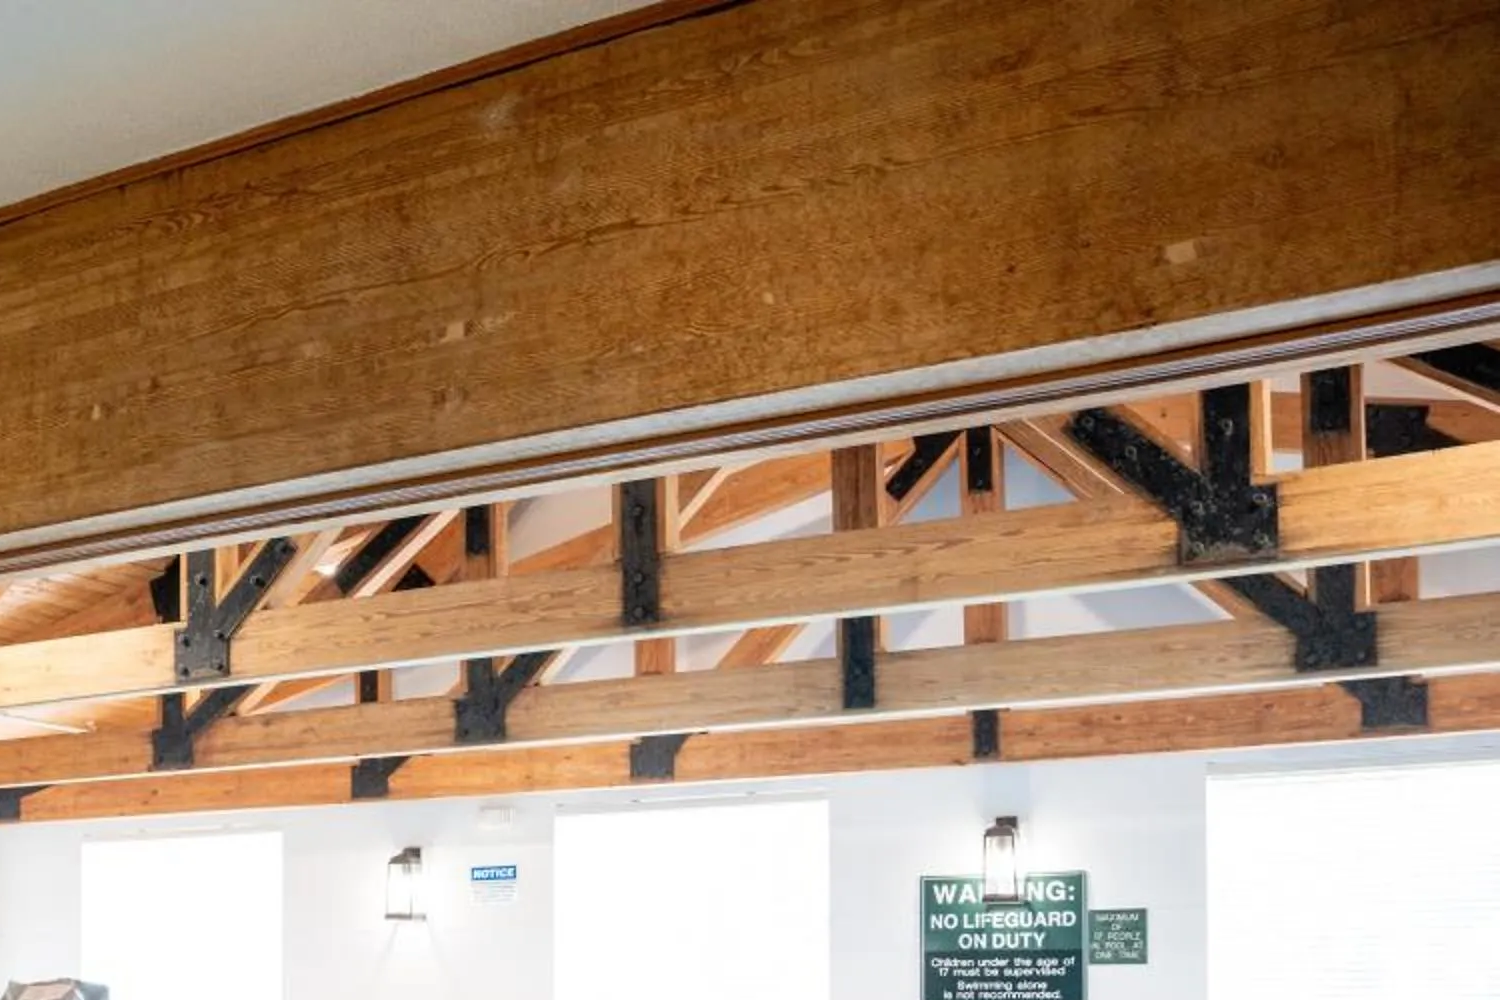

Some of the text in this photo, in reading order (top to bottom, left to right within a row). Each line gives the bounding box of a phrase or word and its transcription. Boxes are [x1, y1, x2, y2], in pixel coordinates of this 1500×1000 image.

[473, 868, 514, 879] NOTICE
[930, 911, 1076, 929] NO LIFEGUARD
[958, 932, 1046, 949] ON DUTY
[931, 955, 1075, 969] Children under the age of
[953, 967, 980, 976] must
[983, 967, 999, 976] be
[957, 980, 1048, 992] Swimming alone
[955, 990, 975, 1000] not
